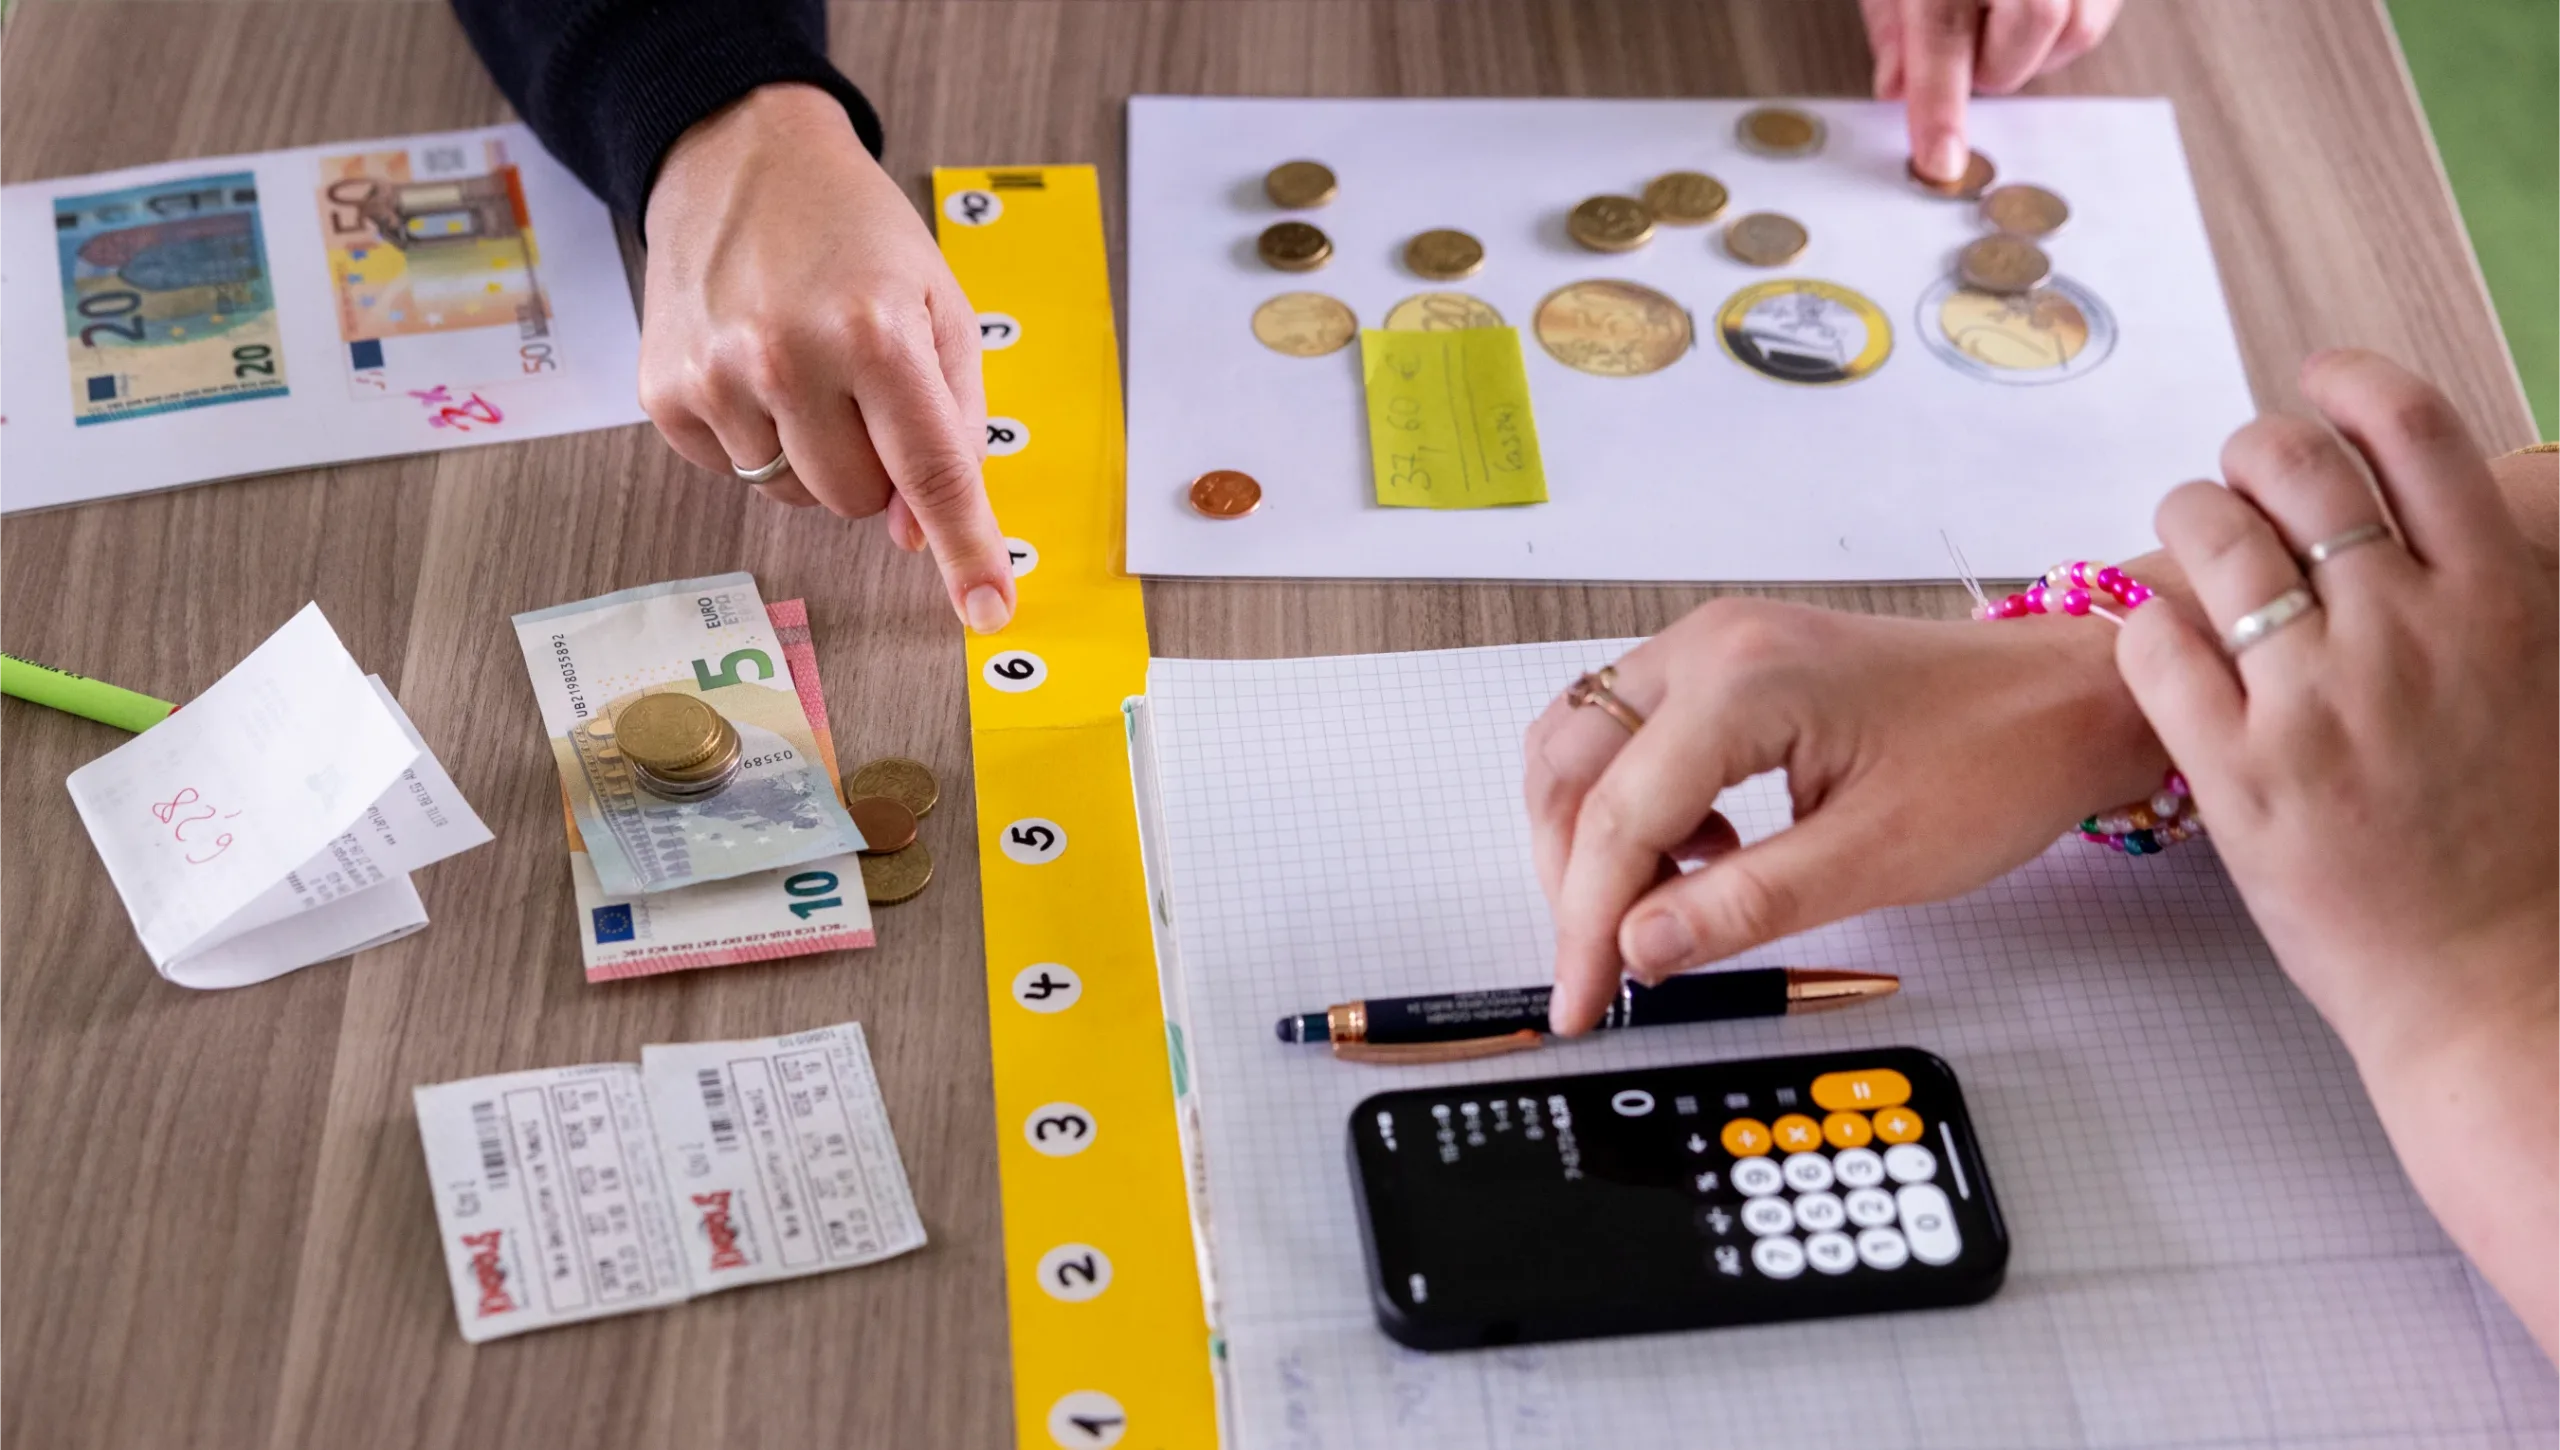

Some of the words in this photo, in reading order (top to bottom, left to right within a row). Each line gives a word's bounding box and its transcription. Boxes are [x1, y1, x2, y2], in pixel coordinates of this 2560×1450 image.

[77, 291, 146, 348] 20
[232, 343, 275, 379] 20
[519, 343, 556, 375] 50
[698, 597, 721, 629] EURO
[552, 633, 588, 718] UB2198035892
[692, 648, 774, 691] 5
[994, 658, 1034, 680] 6
[744, 749, 793, 769] 03589
[409, 782, 433, 807] BELEG
[1010, 825, 1055, 852] 5
[784, 871, 842, 920] 10
[1024, 972, 1071, 1000] 4
[1611, 1089, 1655, 1117] 0
[1036, 1115, 1088, 1142] 3
[1744, 1168, 1771, 1186] 9
[1795, 1164, 1822, 1181] 6
[1845, 1159, 1872, 1178] 3
[1754, 1208, 1782, 1225] 8
[1806, 1203, 1833, 1220] 5
[1857, 1198, 1885, 1217] 2
[1914, 1212, 1942, 1232] 0
[1765, 1248, 1793, 1264] 7
[1817, 1243, 1843, 1261] 4
[1870, 1239, 1896, 1254] 1
[1057, 1252, 1098, 1288] 2
[1068, 1412, 1125, 1438] 1
